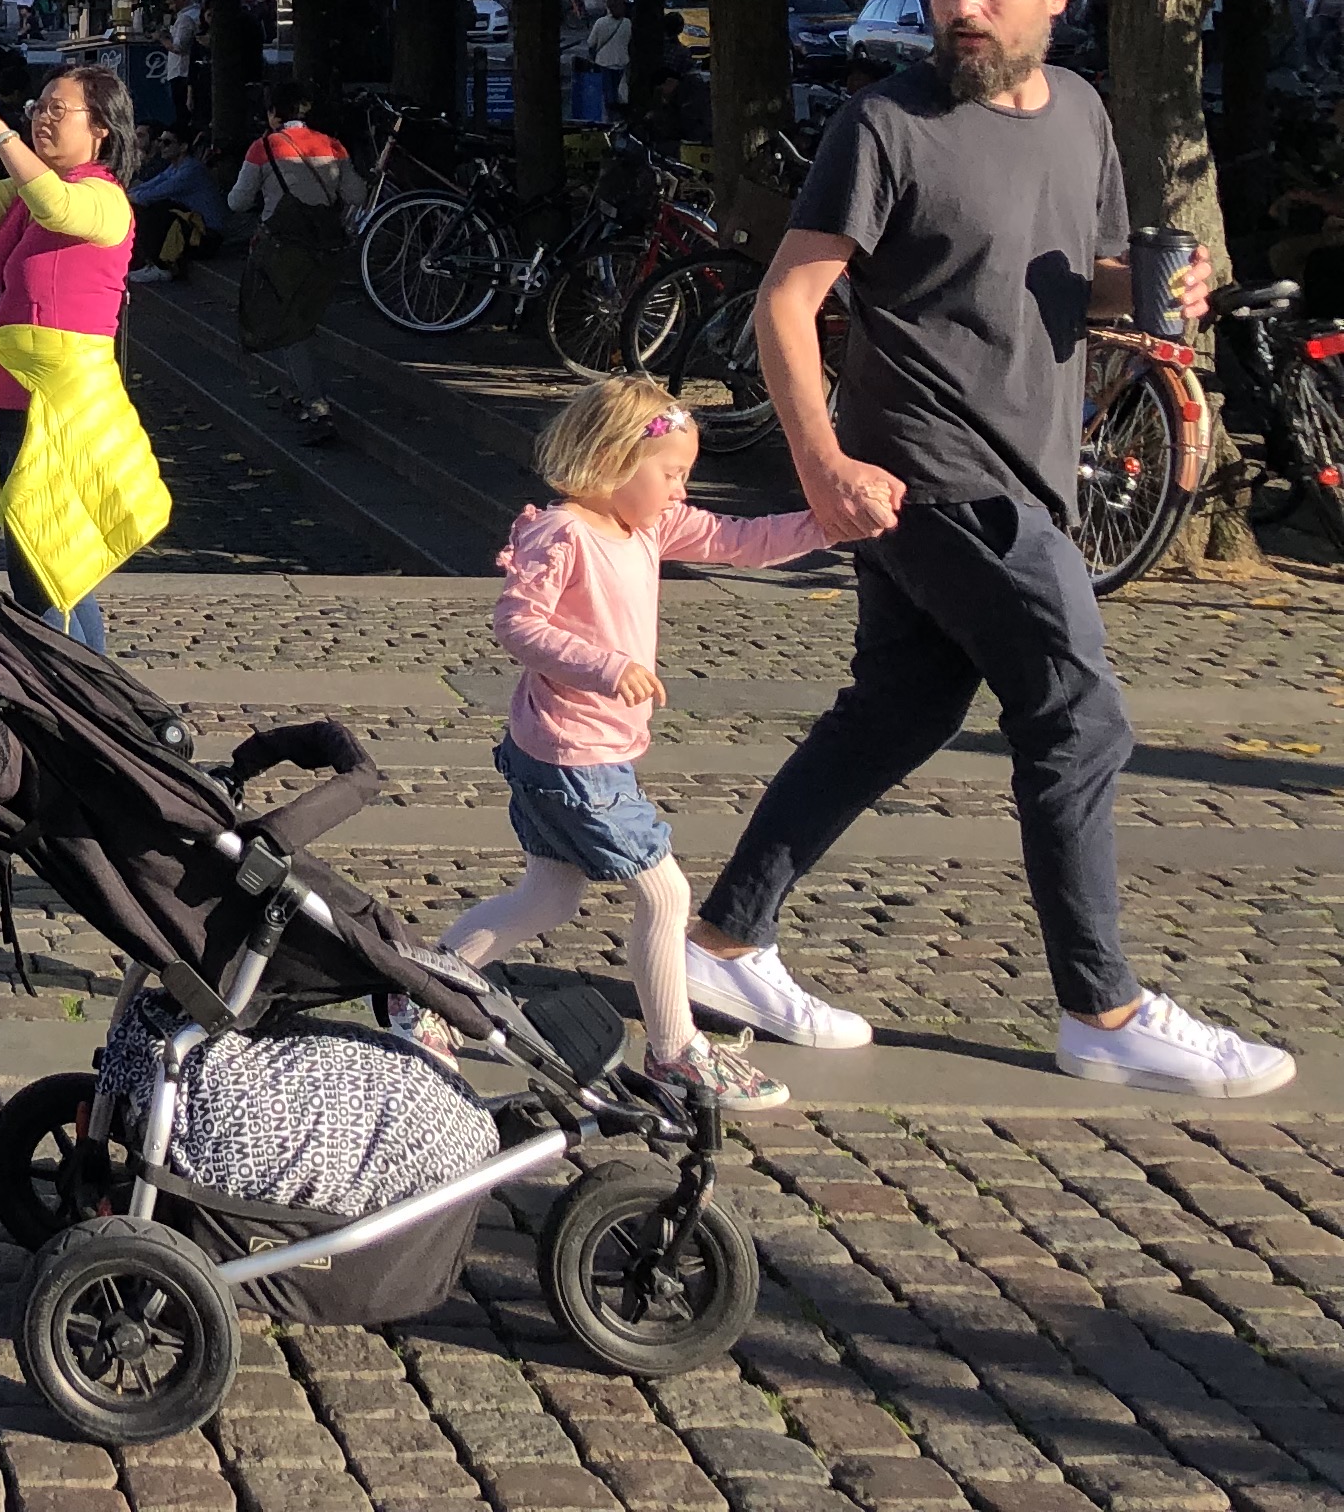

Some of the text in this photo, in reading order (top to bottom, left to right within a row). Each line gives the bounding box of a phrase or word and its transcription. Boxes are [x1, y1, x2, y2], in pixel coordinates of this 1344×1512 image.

[268, 1078, 289, 1133] NOW
[322, 1072, 339, 1184] GREEN GREEN
[335, 1072, 349, 1184] COTTON COTTON
[346, 1073, 364, 1128] NOW
[395, 1098, 434, 1139] GREEN
[407, 1117, 448, 1157] NOW
[416, 1129, 455, 1166] GREEN
